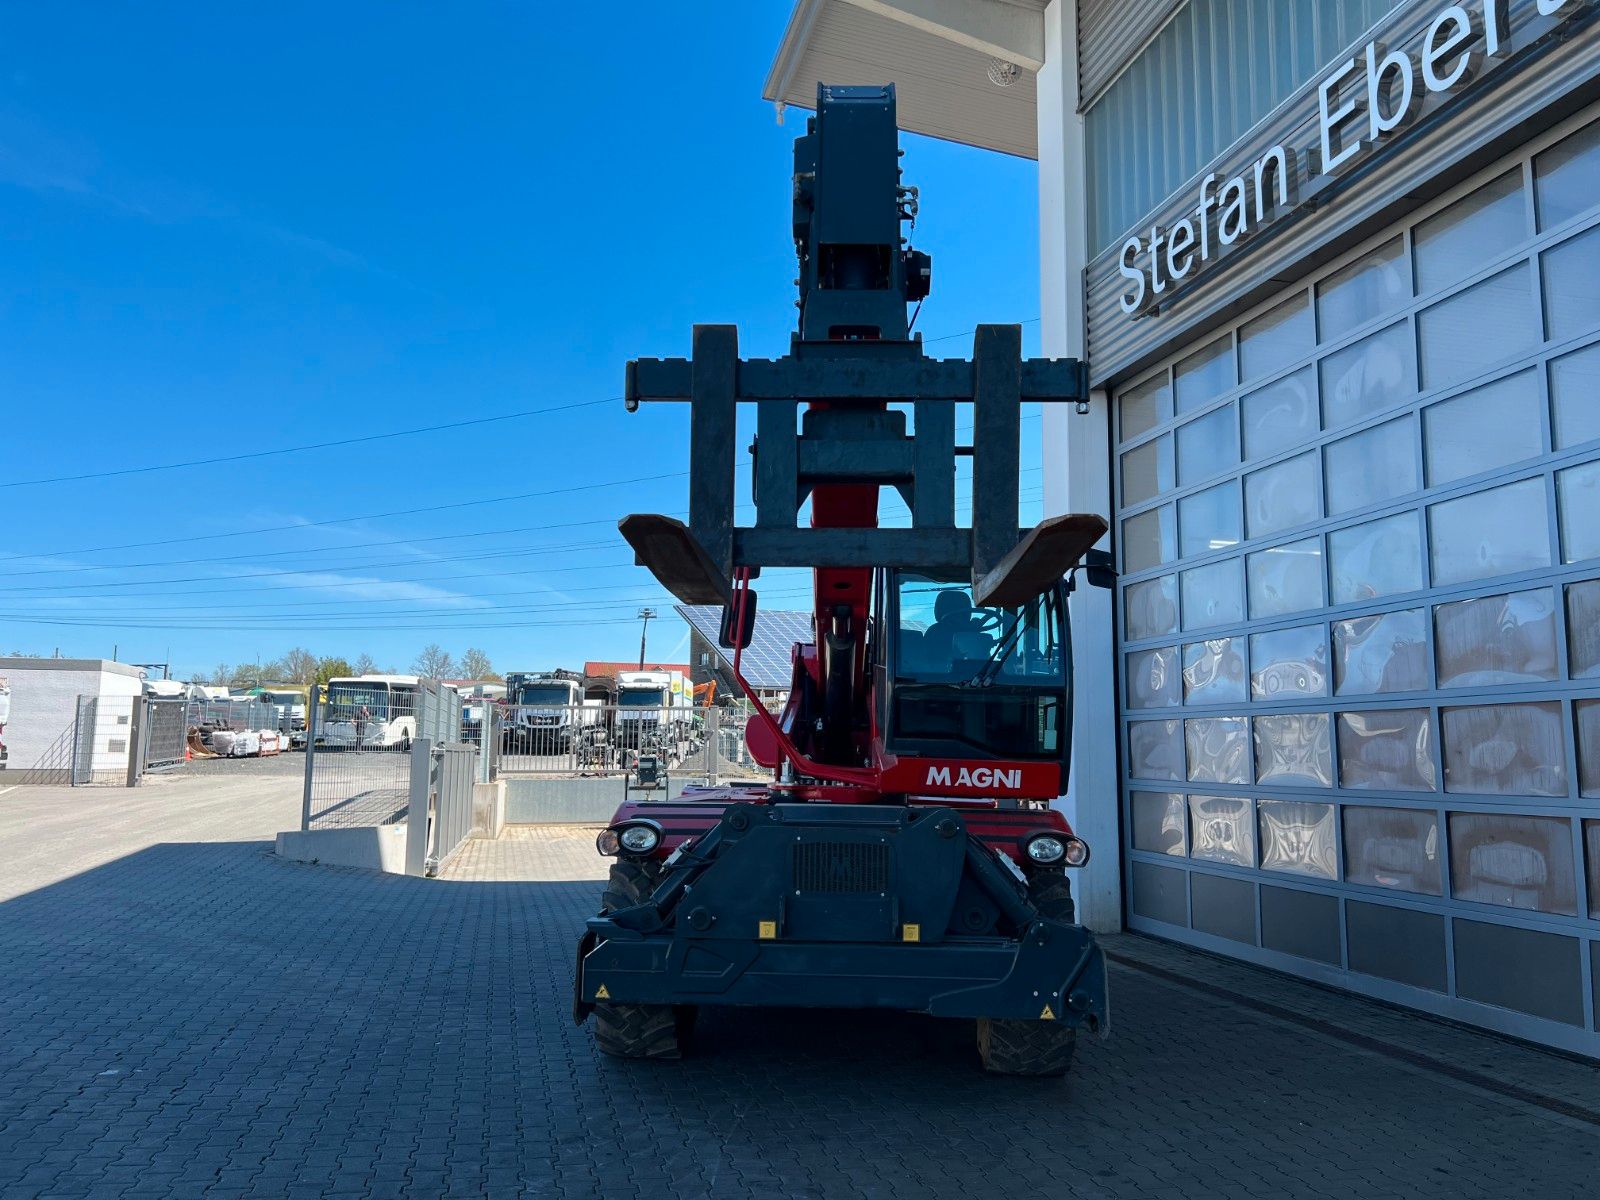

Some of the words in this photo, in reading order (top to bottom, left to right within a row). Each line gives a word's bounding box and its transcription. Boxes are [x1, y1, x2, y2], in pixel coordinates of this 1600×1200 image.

[1119, 144, 1288, 314] Stefan
[1317, 0, 1568, 177] Ebe
[925, 766, 1022, 789] MAGNI
